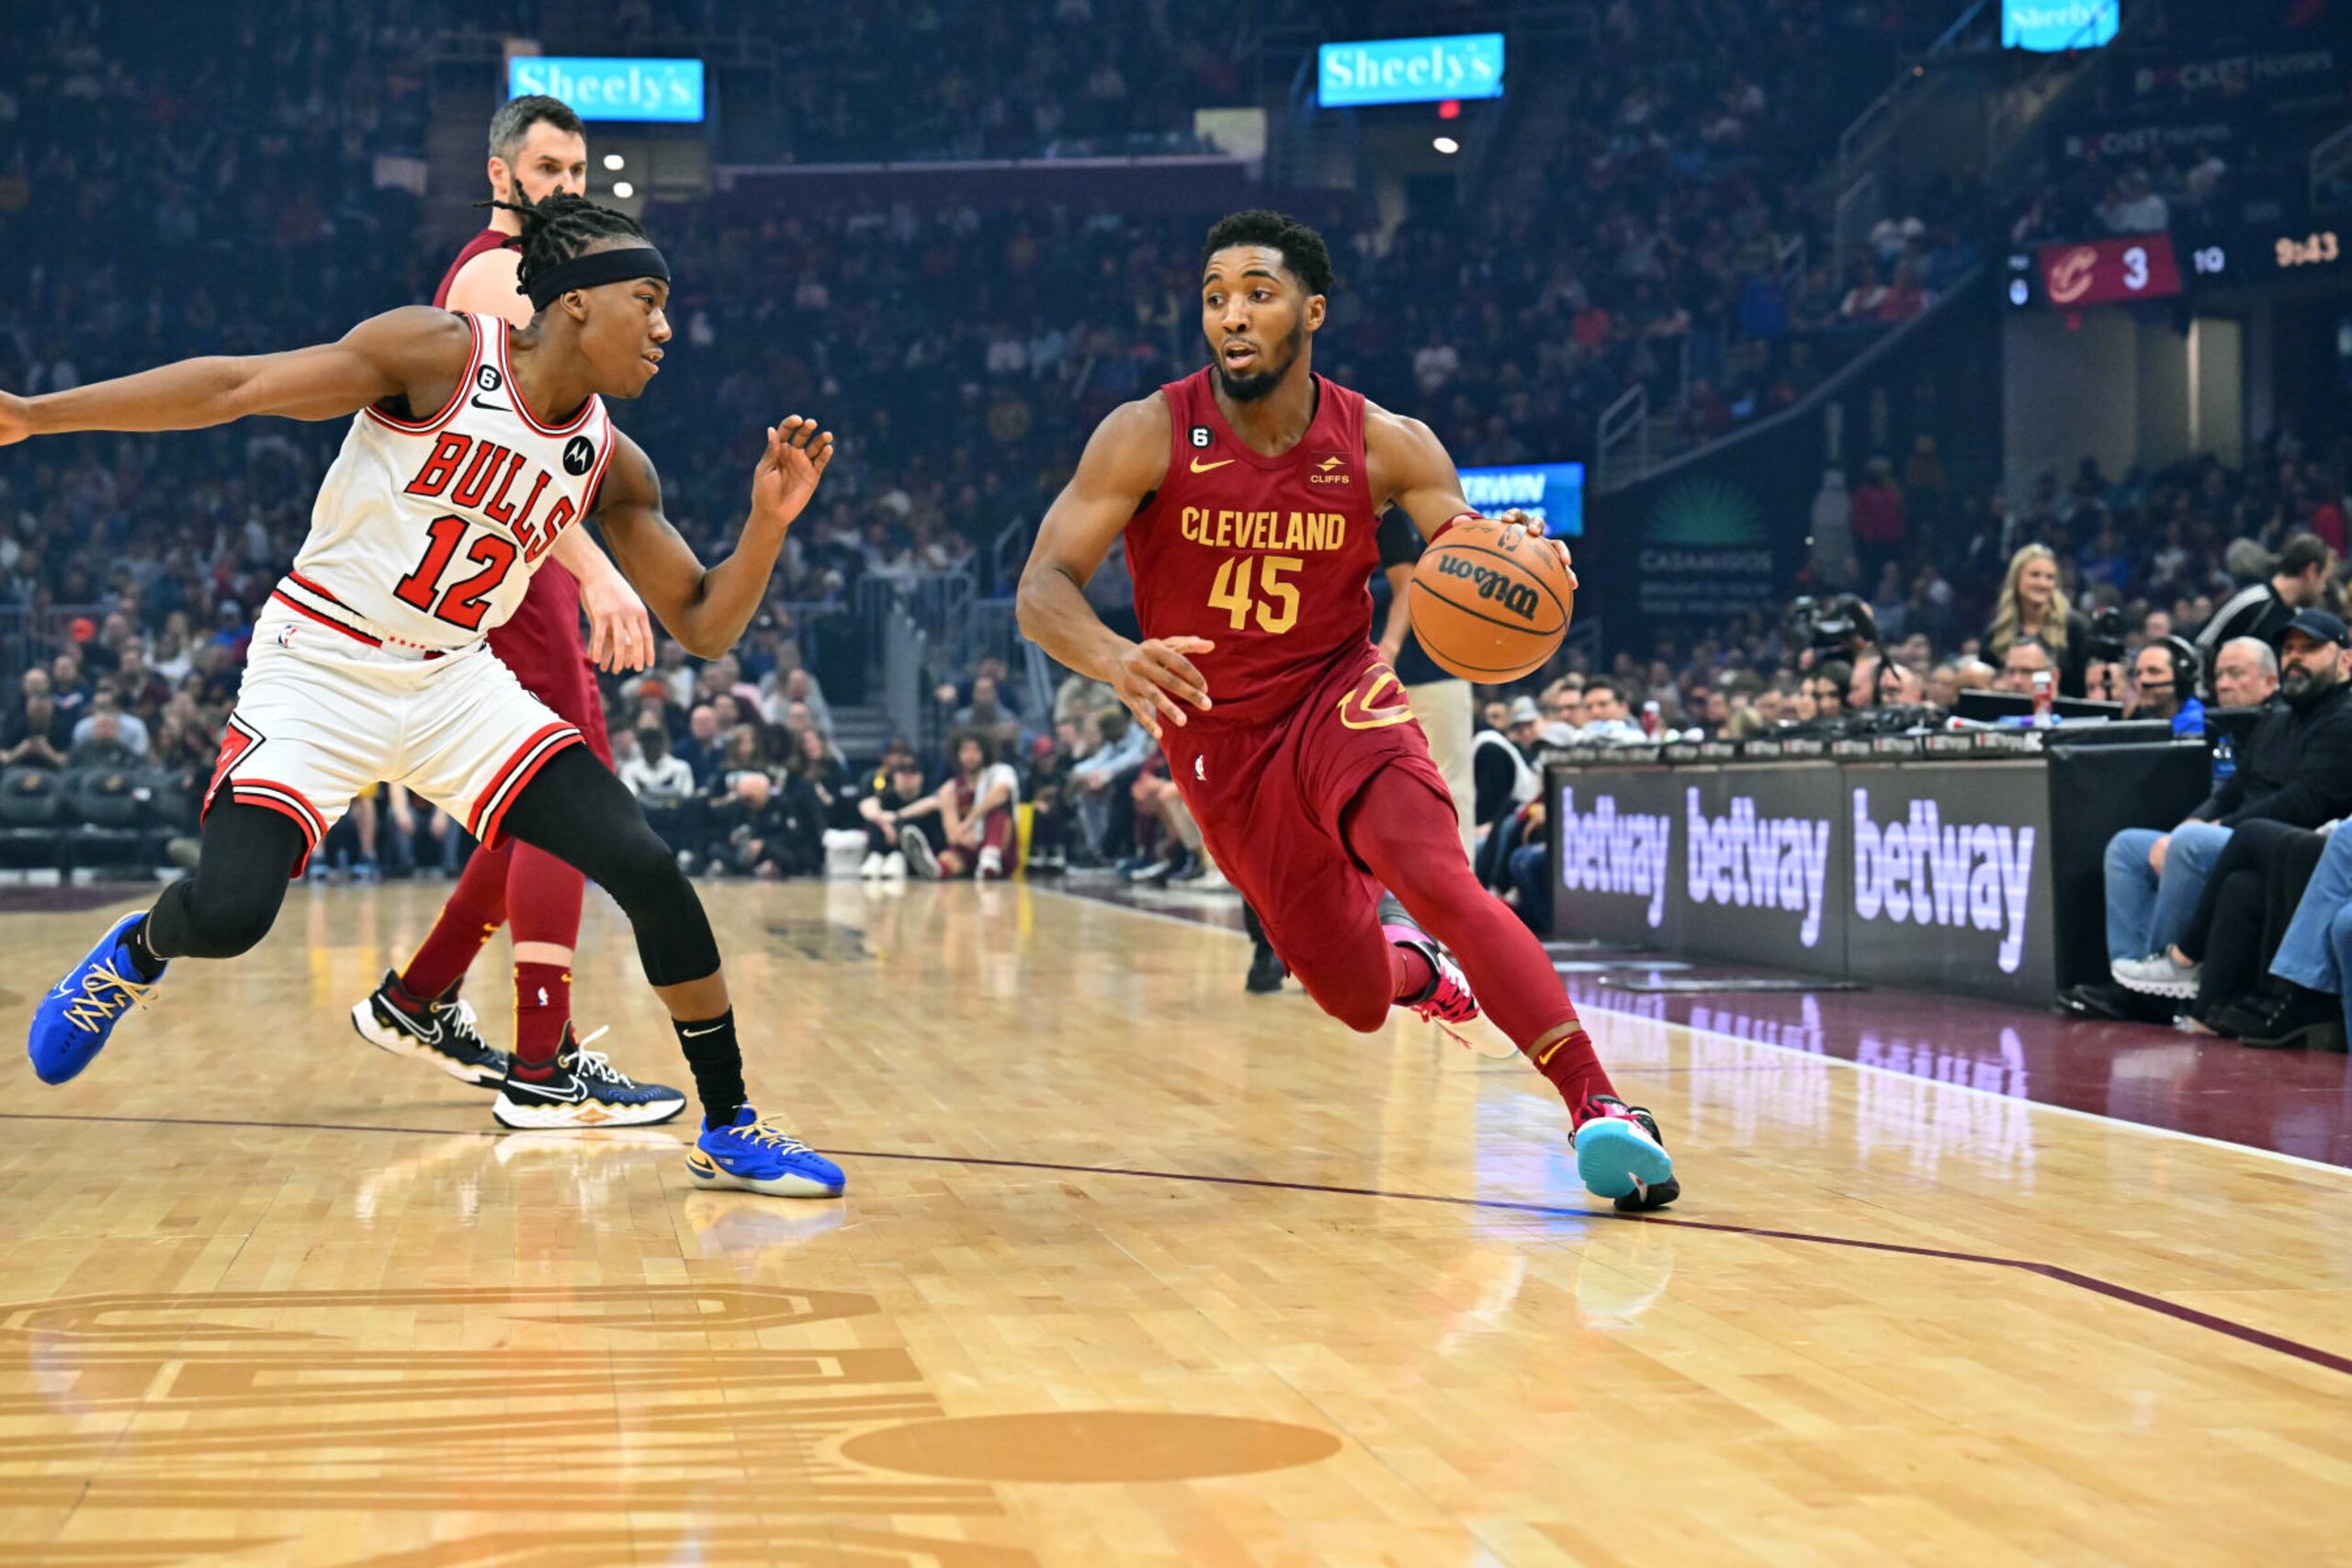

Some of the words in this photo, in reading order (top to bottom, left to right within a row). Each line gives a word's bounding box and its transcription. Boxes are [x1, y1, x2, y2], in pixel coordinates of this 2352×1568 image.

[516, 63, 693, 109] Sheely's
[1326, 42, 1493, 89] Sheely's
[2123, 247, 2149, 290] 3
[481, 368, 496, 389] 6
[1193, 428, 1208, 446] 6
[403, 430, 576, 564] BULLS
[1310, 474, 1350, 485] CLIFFS
[1182, 506, 1346, 551] CLEVELAND
[392, 513, 517, 632] 12
[1207, 555, 1304, 634] 45
[1439, 553, 1539, 622] Wilson
[1563, 785, 1669, 928] betway
[1687, 785, 1829, 947] betway
[1853, 787, 2035, 973] betway
